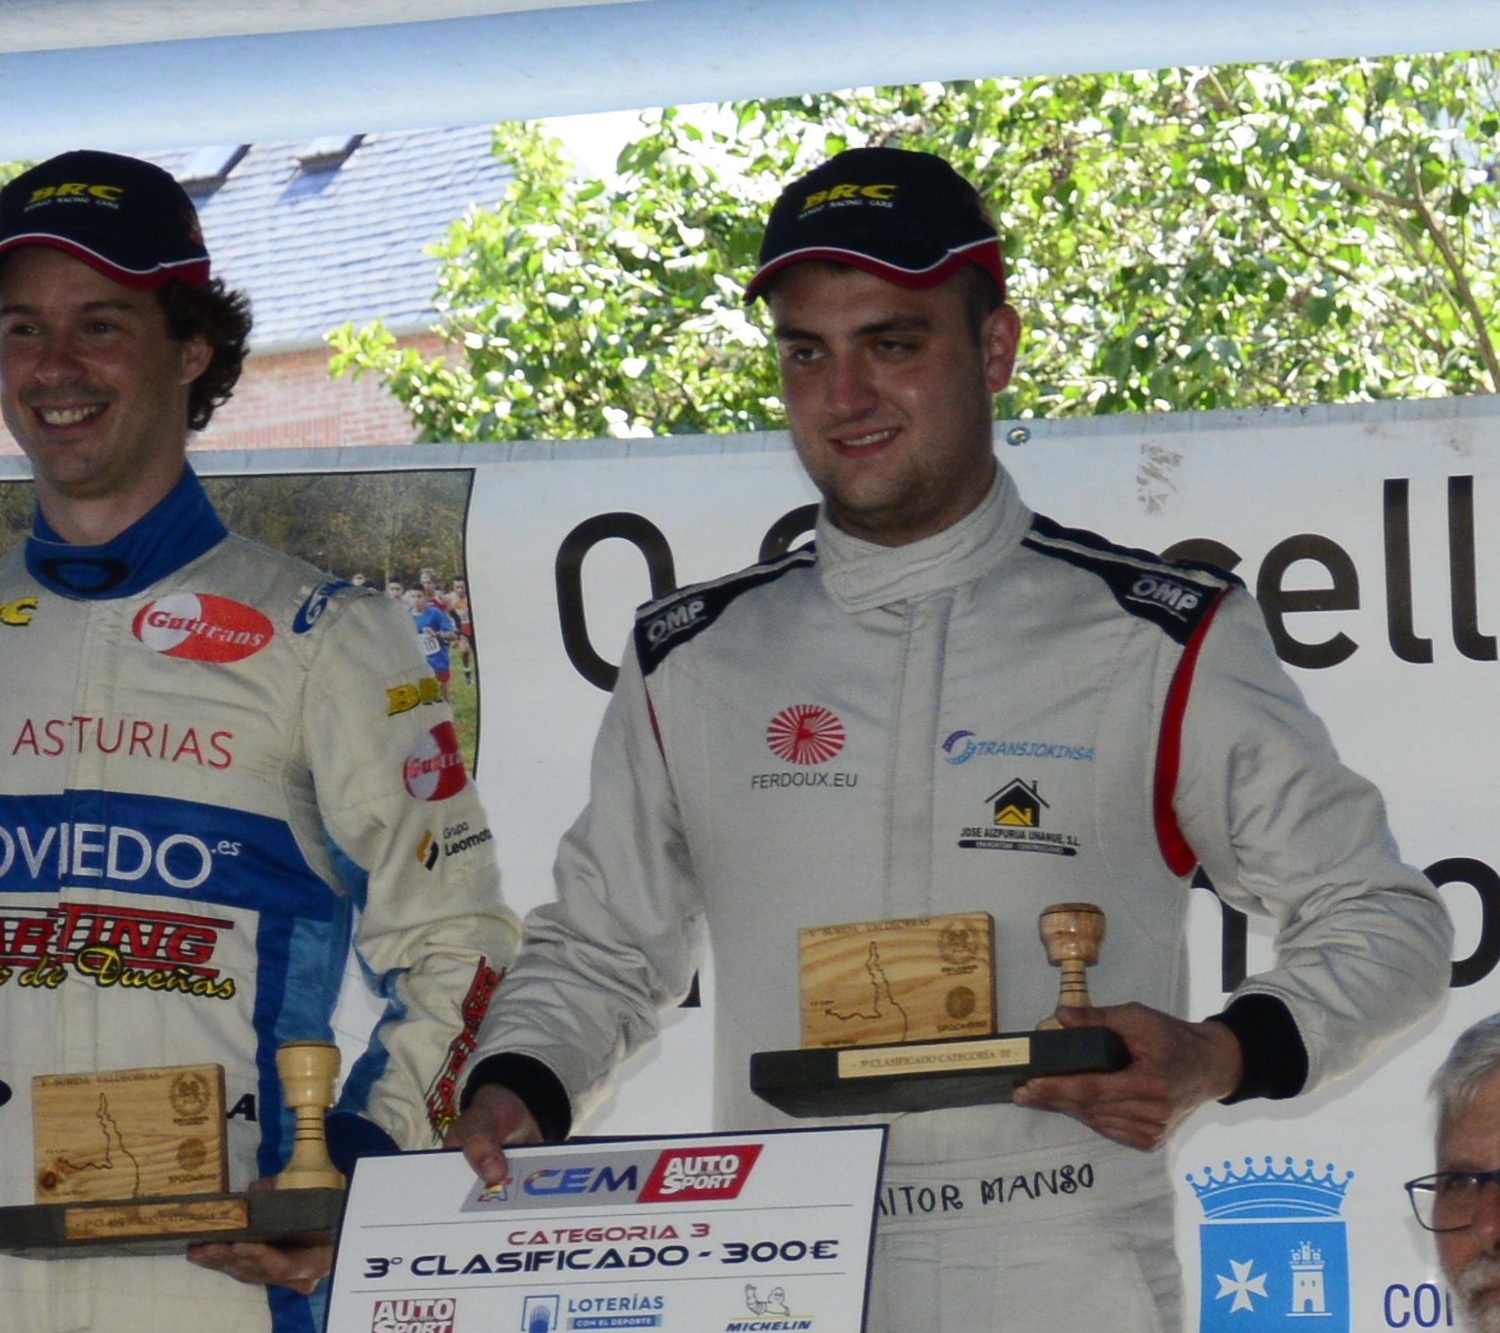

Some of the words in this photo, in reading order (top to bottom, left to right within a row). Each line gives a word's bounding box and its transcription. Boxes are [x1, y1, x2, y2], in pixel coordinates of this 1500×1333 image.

[27, 182, 125, 204] BRC
[802, 183, 900, 212] BRC
[869, 199, 894, 209] CARS
[553, 510, 676, 692] O
[1131, 575, 1200, 613] OMP
[646, 601, 706, 645] OMP
[13, 716, 235, 771] ASTURIAS
[750, 772, 859, 790] FERDOUX.EU
[960, 827, 981, 838] JOSE
[77, 945, 236, 999] Dueñas
[663, 1153, 739, 1178] AUTO
[522, 1164, 638, 1197] CEM
[660, 1170, 738, 1196] SPORT
[980, 1162, 1095, 1206] MANSO
[507, 1226, 679, 1247] CATEGORIA
[691, 1222, 710, 1238] 3
[363, 1255, 404, 1279] 3º
[409, 1244, 690, 1278] CLASIFICADO
[721, 1238, 840, 1264] 300€
[372, 1299, 455, 1324] AUTO
[566, 1293, 665, 1313] LOTERÍAS
[610, 1317, 652, 1326] DEPORTE
[724, 1319, 812, 1333] MICHELIN
